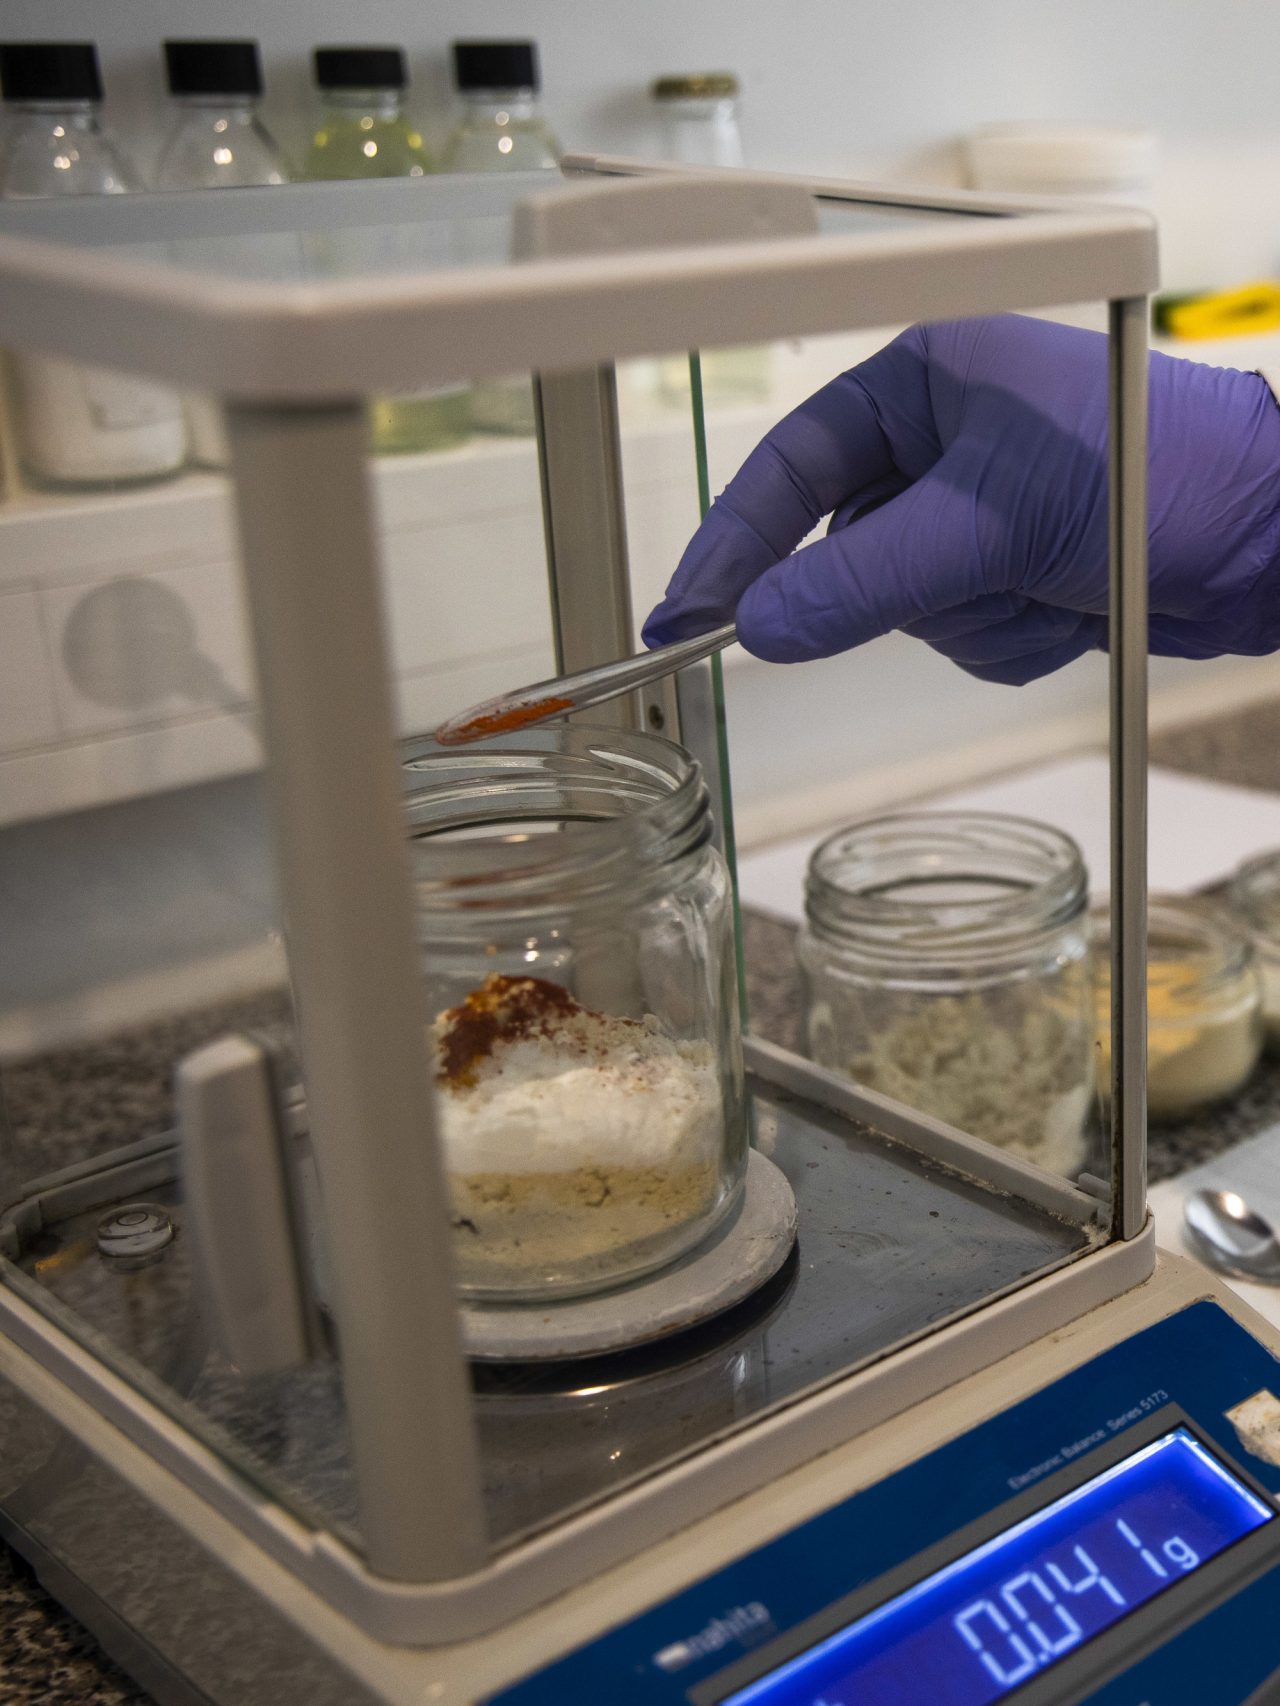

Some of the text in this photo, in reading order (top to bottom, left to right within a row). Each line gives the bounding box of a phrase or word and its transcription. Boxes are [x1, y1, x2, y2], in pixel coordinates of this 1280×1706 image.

[1060, 1428, 1106, 1459] Balance
[1106, 1407, 1143, 1431] Series
[1139, 1389, 1169, 1411] 5173
